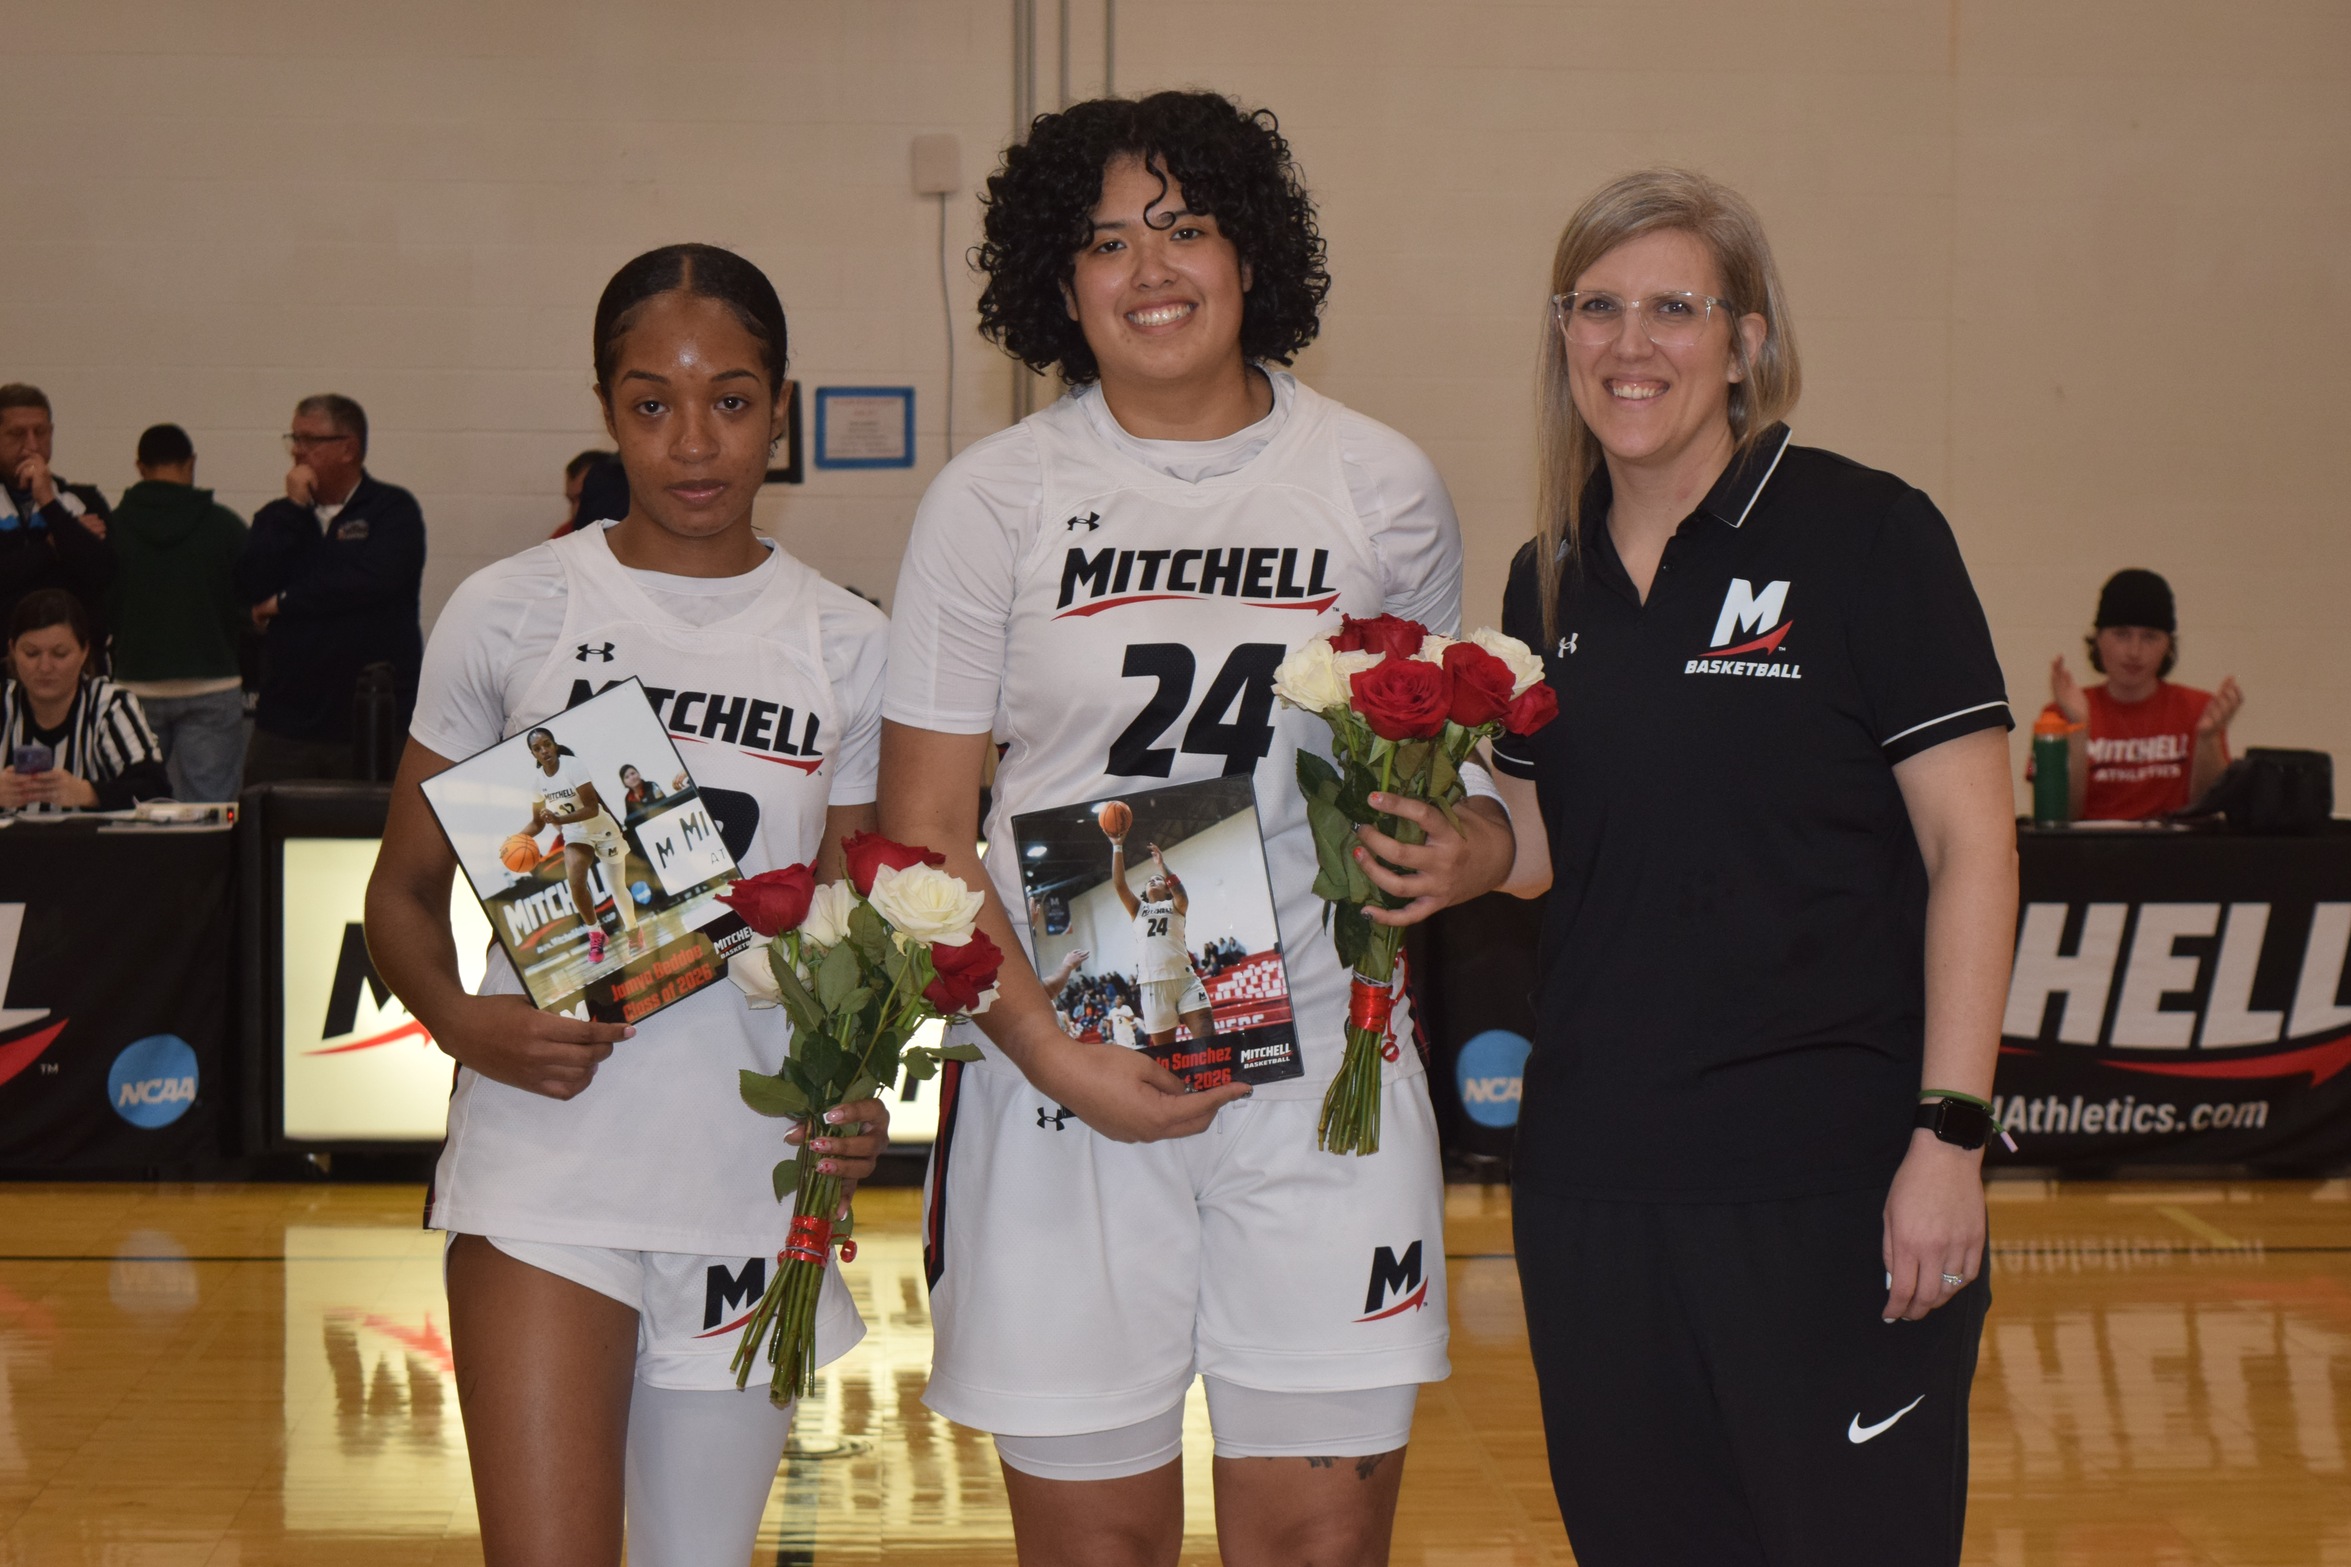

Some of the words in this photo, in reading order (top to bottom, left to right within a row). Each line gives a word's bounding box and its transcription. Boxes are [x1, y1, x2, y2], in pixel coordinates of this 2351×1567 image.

[1056, 547, 1337, 610] MITCHELL
[1710, 578, 1791, 648] M
[1684, 660, 1802, 679] BASKETBALL
[565, 678, 823, 757] TCHELL
[1104, 642, 1287, 778] 24
[503, 861, 614, 947] MITCHLL
[1147, 917, 1168, 937] 24
[622, 992, 662, 1023] Class
[660, 983, 677, 1003] of
[676, 962, 714, 995] 2026
[40, 1063, 59, 1075] TM
[1172, 1047, 1232, 1071] Sanchez
[1240, 1043, 1293, 1063] MITCHELL
[1244, 1056, 1291, 1069] BASKETBALL
[119, 1077, 197, 1107] NCAA
[1194, 1068, 1232, 1090] 2026
[703, 1258, 766, 1331] M
[1364, 1239, 1423, 1315] M
